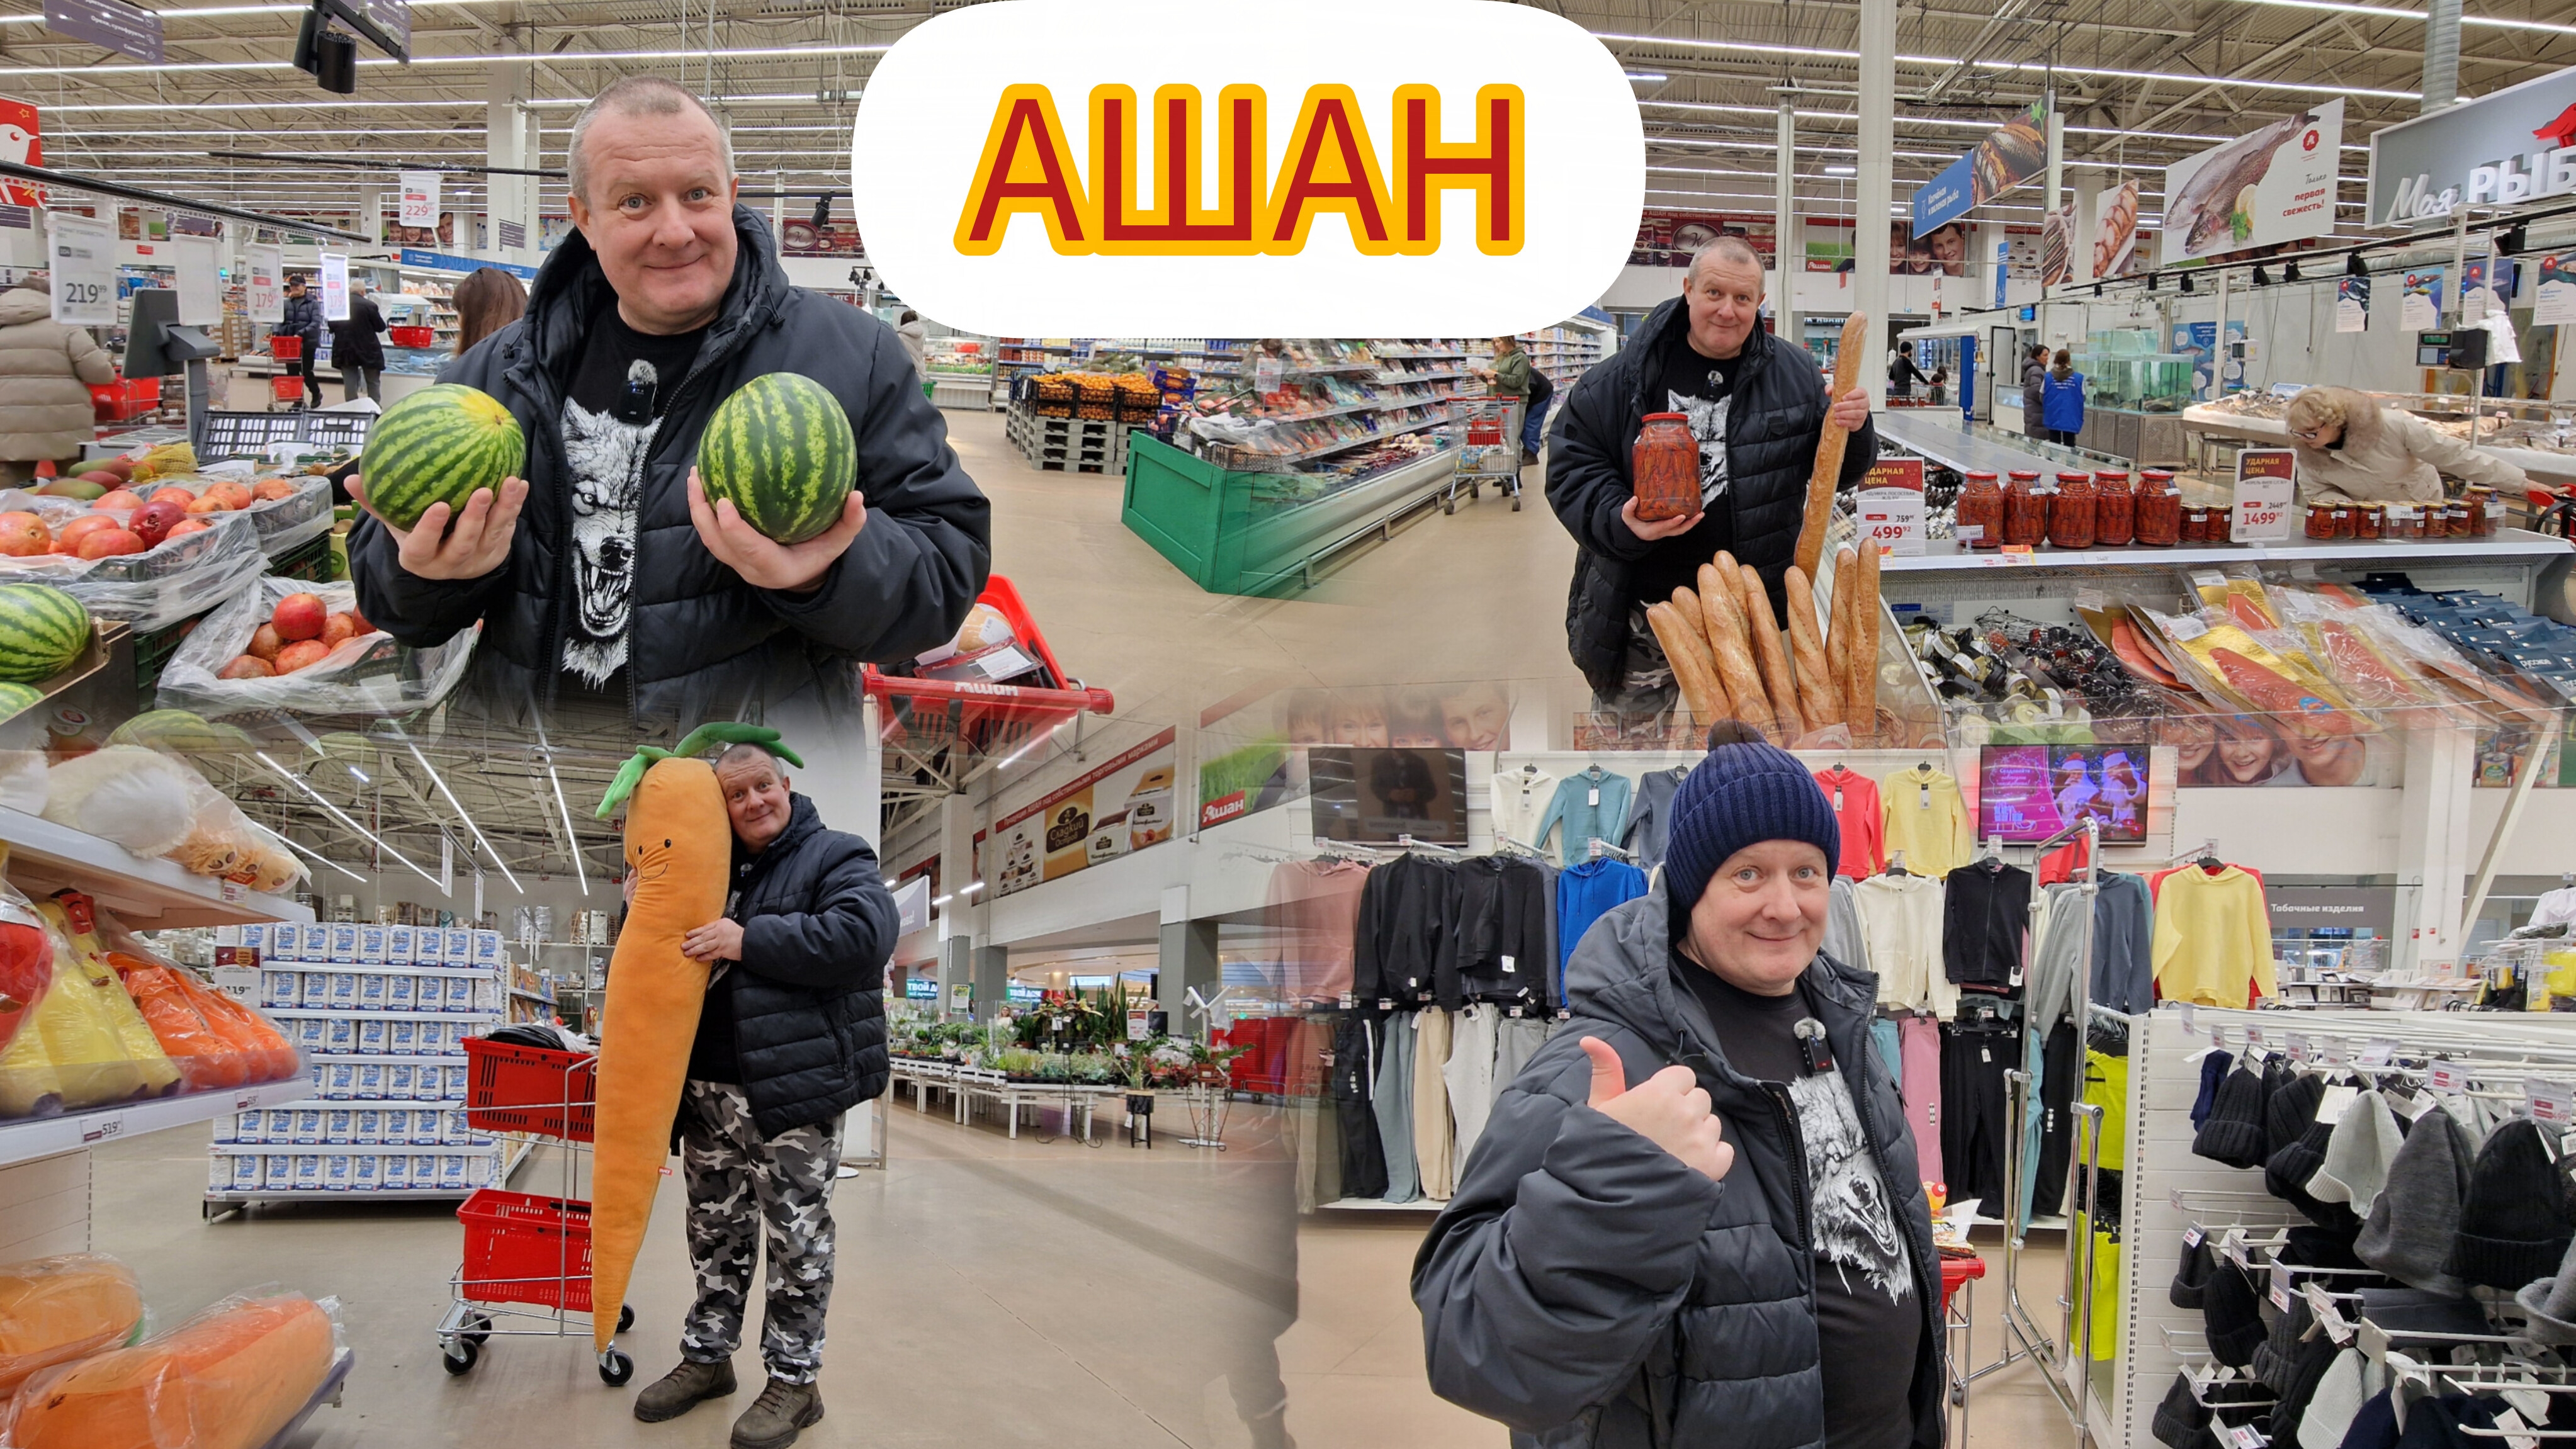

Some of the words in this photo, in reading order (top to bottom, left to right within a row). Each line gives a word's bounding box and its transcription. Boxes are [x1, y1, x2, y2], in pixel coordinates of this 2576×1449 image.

[2294, 188, 2325, 202] первая
[2385, 173, 2459, 222] Моя
[405, 205, 428, 216] 229
[2282, 198, 2325, 217] свежесть!
[65, 282, 99, 303] 219
[256, 292, 274, 308] 179
[2246, 458, 2279, 466] УДАРНАЯ
[1867, 468, 1905, 476] ДАРНАЯ
[2246, 467, 2265, 475] ЦЕНА
[1864, 476, 1889, 485] ЦЕНА
[2243, 512, 2276, 525] 1499
[1872, 526, 1903, 539] 499
[1127, 738, 1159, 760] марками
[1202, 799, 1244, 823] Ашан
[1050, 818, 1084, 840] Сладкий
[1055, 833, 1078, 847] Остров
[2271, 904, 2320, 912] Табачные
[2322, 905, 2364, 913] изделия
[907, 982, 929, 991] ТВОЙ
[102, 1122, 118, 1135] 519
